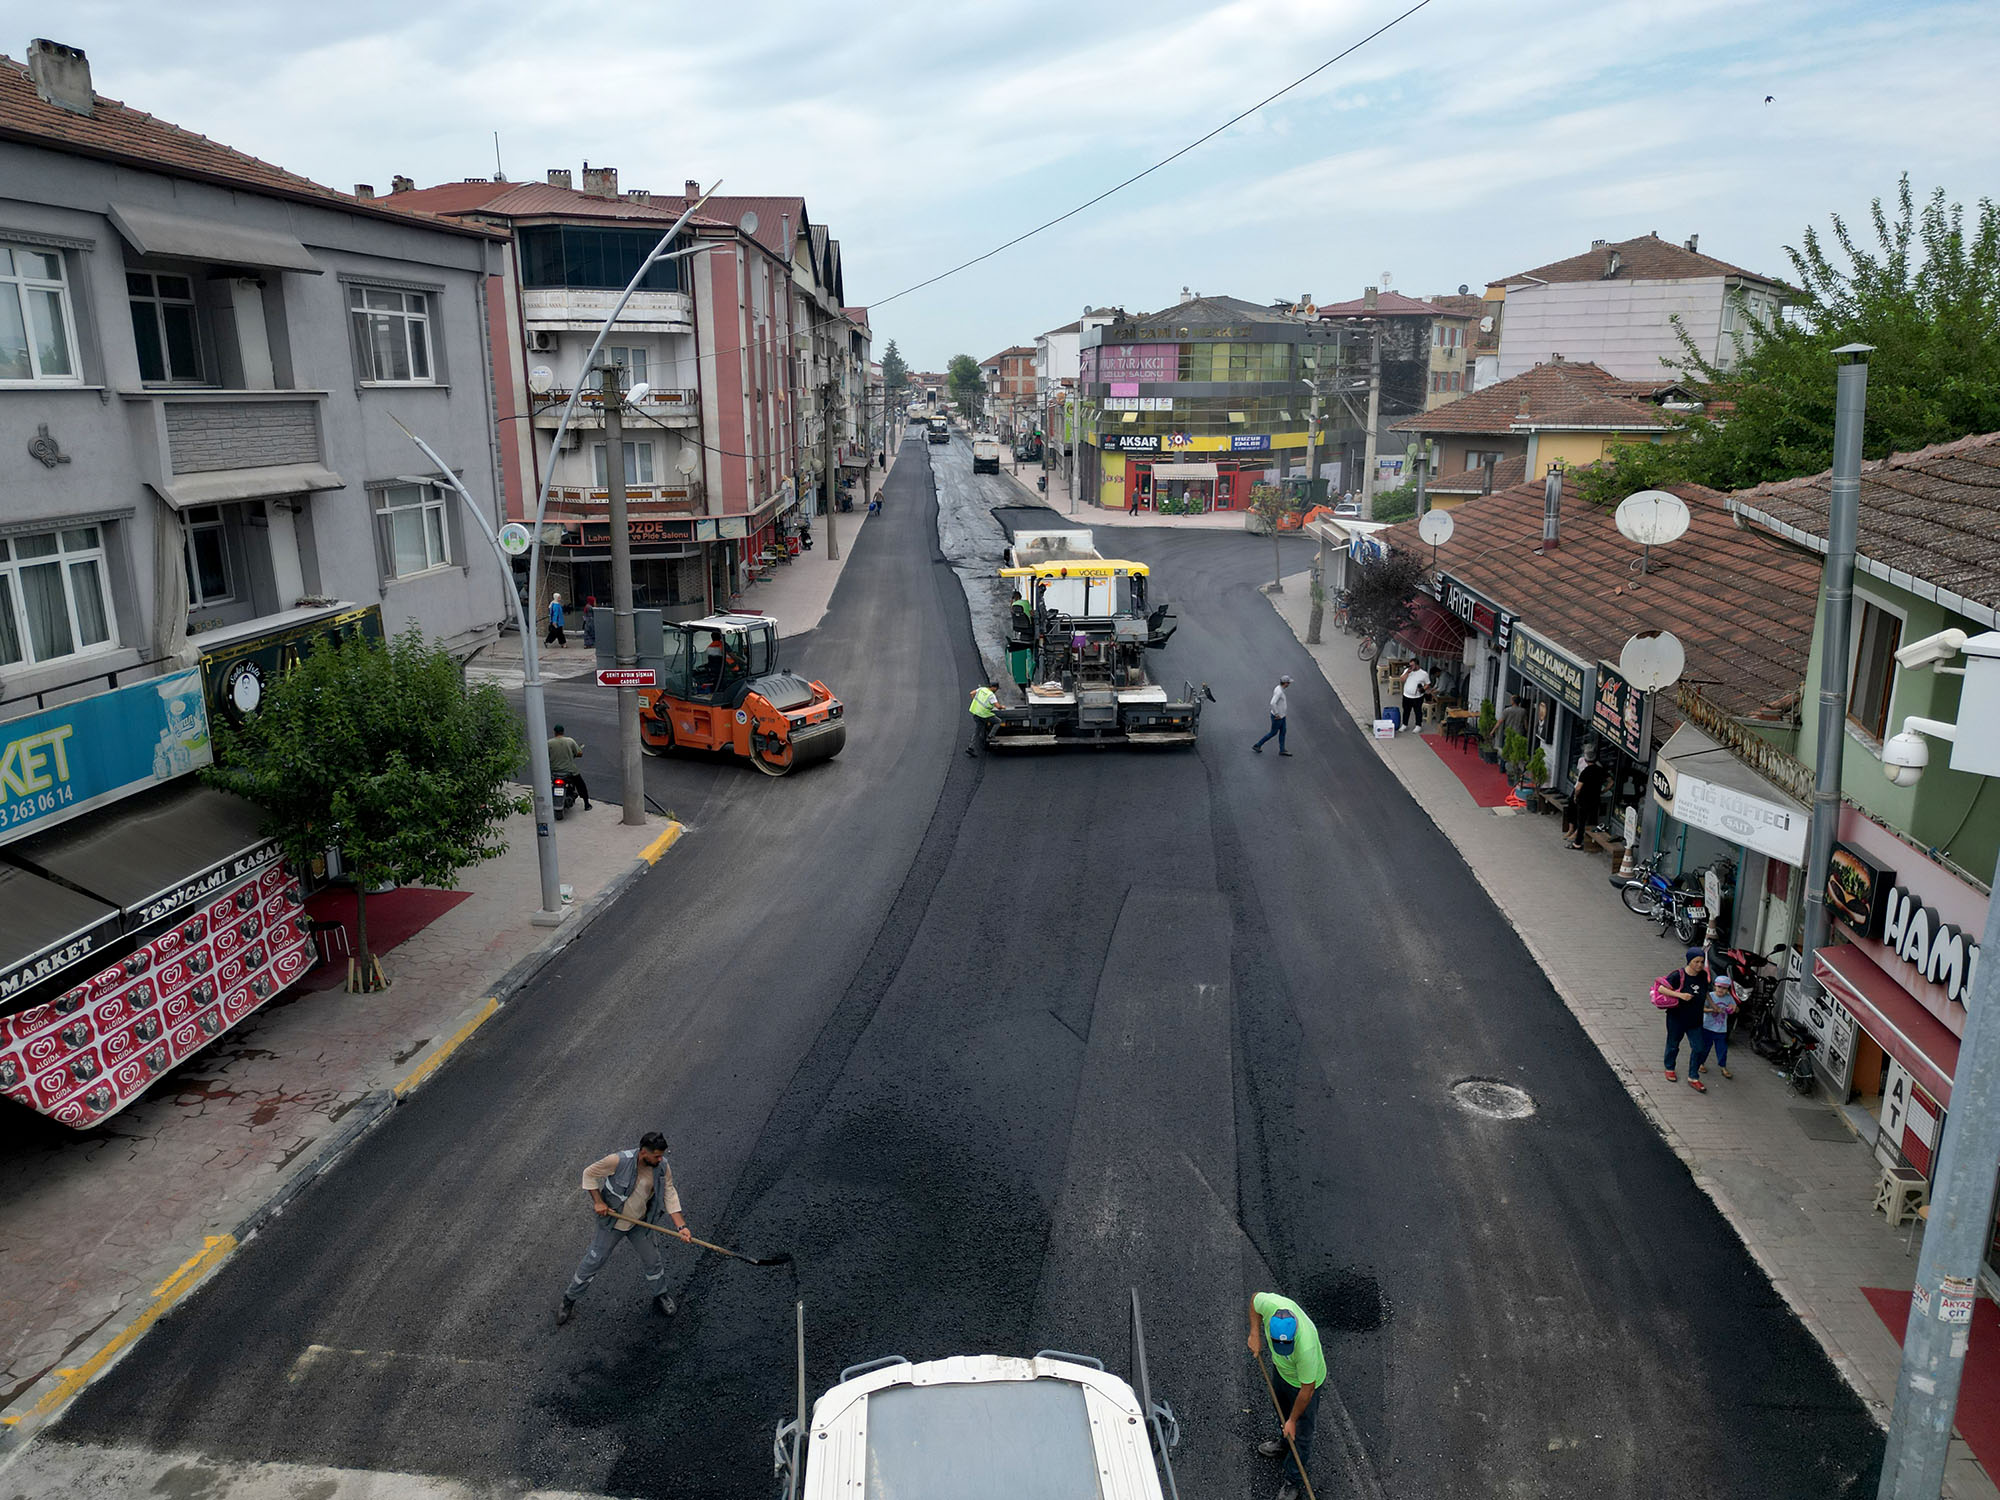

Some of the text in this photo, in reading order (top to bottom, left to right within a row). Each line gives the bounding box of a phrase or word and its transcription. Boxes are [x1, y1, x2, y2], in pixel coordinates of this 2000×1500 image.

[1119, 436, 1158, 447] AKSAR
[642, 532, 660, 540] Pide
[661, 531, 689, 539] Salonu
[10, 798, 36, 823] 263
[38, 791, 55, 812] 06
[56, 784, 73, 804] 14
[0, 935, 92, 998] MARKET
[1942, 1298, 1971, 1310] AKYAZ
